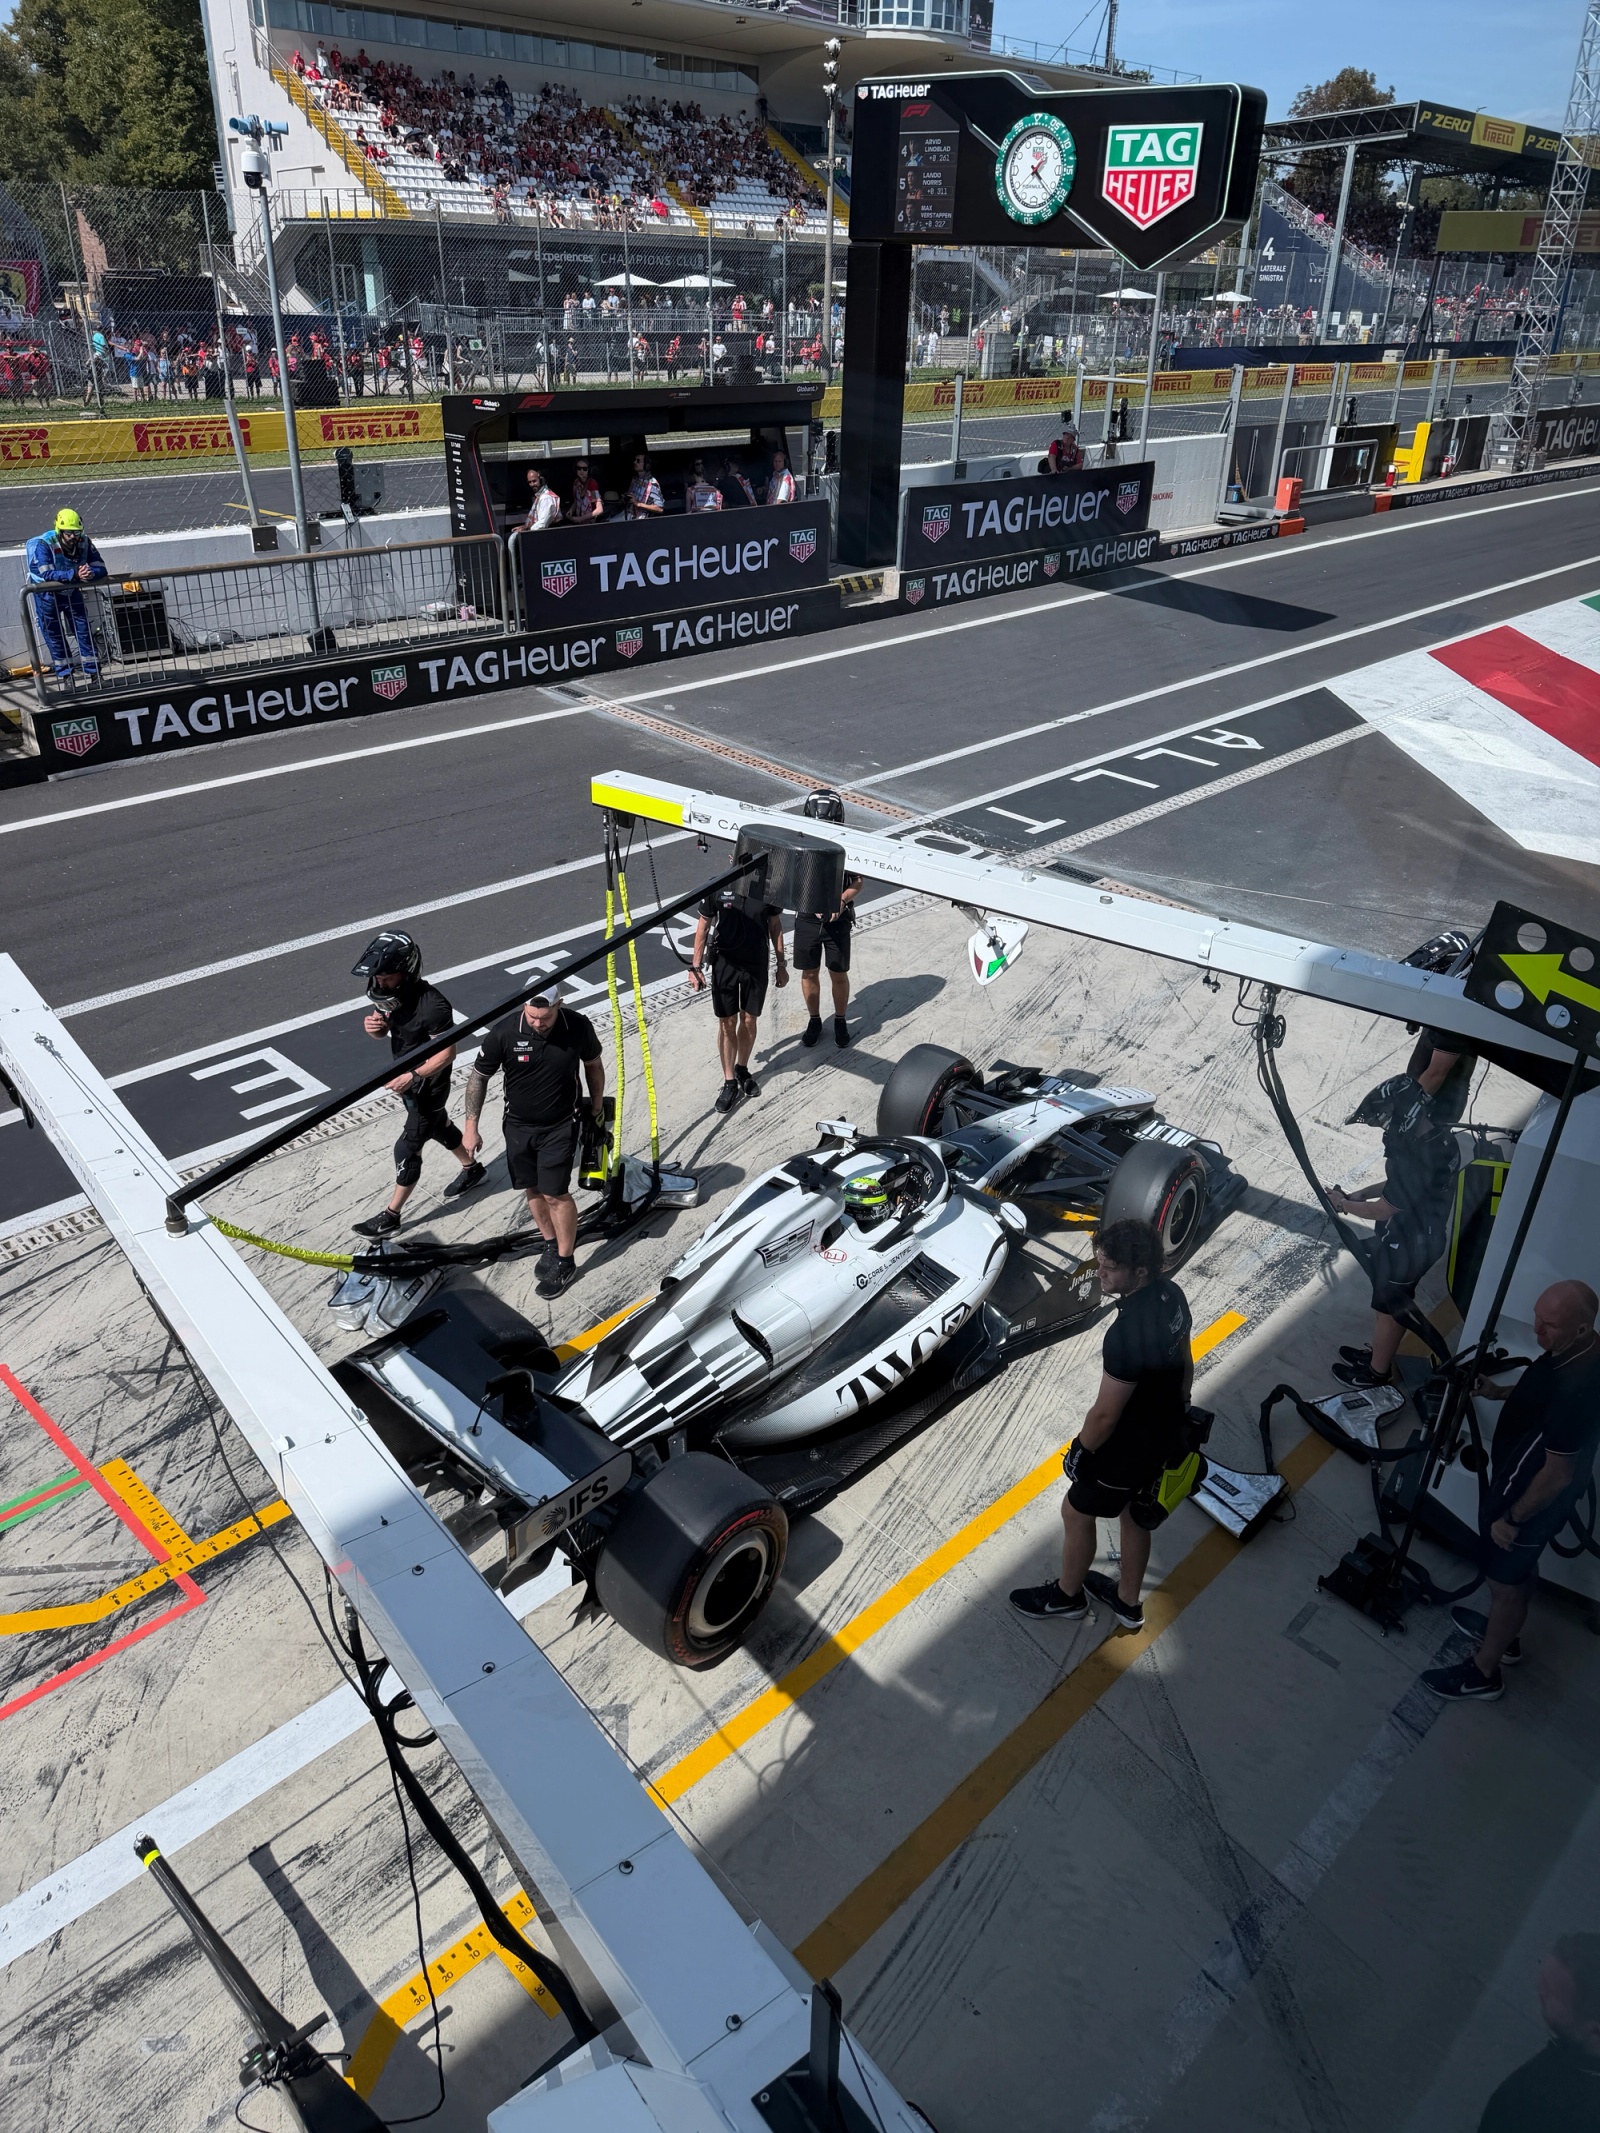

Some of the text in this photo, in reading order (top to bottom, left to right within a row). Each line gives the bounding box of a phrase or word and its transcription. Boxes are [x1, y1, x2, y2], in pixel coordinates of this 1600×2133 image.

[1419, 110, 1472, 133] P ZERO
[1483, 120, 1516, 146] PIRELLI
[1115, 131, 1192, 163] TAG
[1525, 134, 1536, 147] P
[901, 145, 908, 157] 4
[924, 145, 951, 153] LINDBLAD
[1065, 165, 1074, 175] 15
[899, 178, 906, 190] 5
[1108, 173, 1190, 221] HEUER
[898, 210, 904, 222] 6
[1262, 237, 1275, 261] 4
[1260, 265, 1287, 273] LATERALE
[1259, 274, 1284, 282] SINISTRA
[1154, 374, 1193, 392] PIRELLI
[1014, 380, 1062, 401] PIRELLI
[320, 410, 420, 442] PIRELLI
[1120, 483, 1139, 494] TAG
[1152, 491, 1173, 502] SMOKING
[926, 506, 949, 519] TAG
[792, 530, 815, 543] TAG
[923, 521, 949, 541] HEUER
[790, 543, 816, 563] HEUER
[1045, 554, 1060, 564] TAG
[544, 561, 575, 575] TAG
[543, 575, 577, 597] HEUER
[908, 580, 925, 590] TAG
[617, 629, 641, 641] TAG
[616, 639, 643, 657] HEUER
[374, 668, 405, 682] TAG
[374, 680, 407, 700] HEUER
[55, 720, 95, 734] TAG
[56, 732, 99, 756] HEUER
[872, 861, 903, 874] TEAM
[1068, 1267, 1098, 1292] JIM BEA
[569, 1475, 609, 1520] IFS
[521, 1906, 533, 1917] 10
[468, 1949, 481, 1960] 10
[515, 1961, 526, 1973] 20
[441, 1971, 454, 1983] 20
[534, 1985, 546, 1996] 30
[413, 1993, 427, 2006] 30
